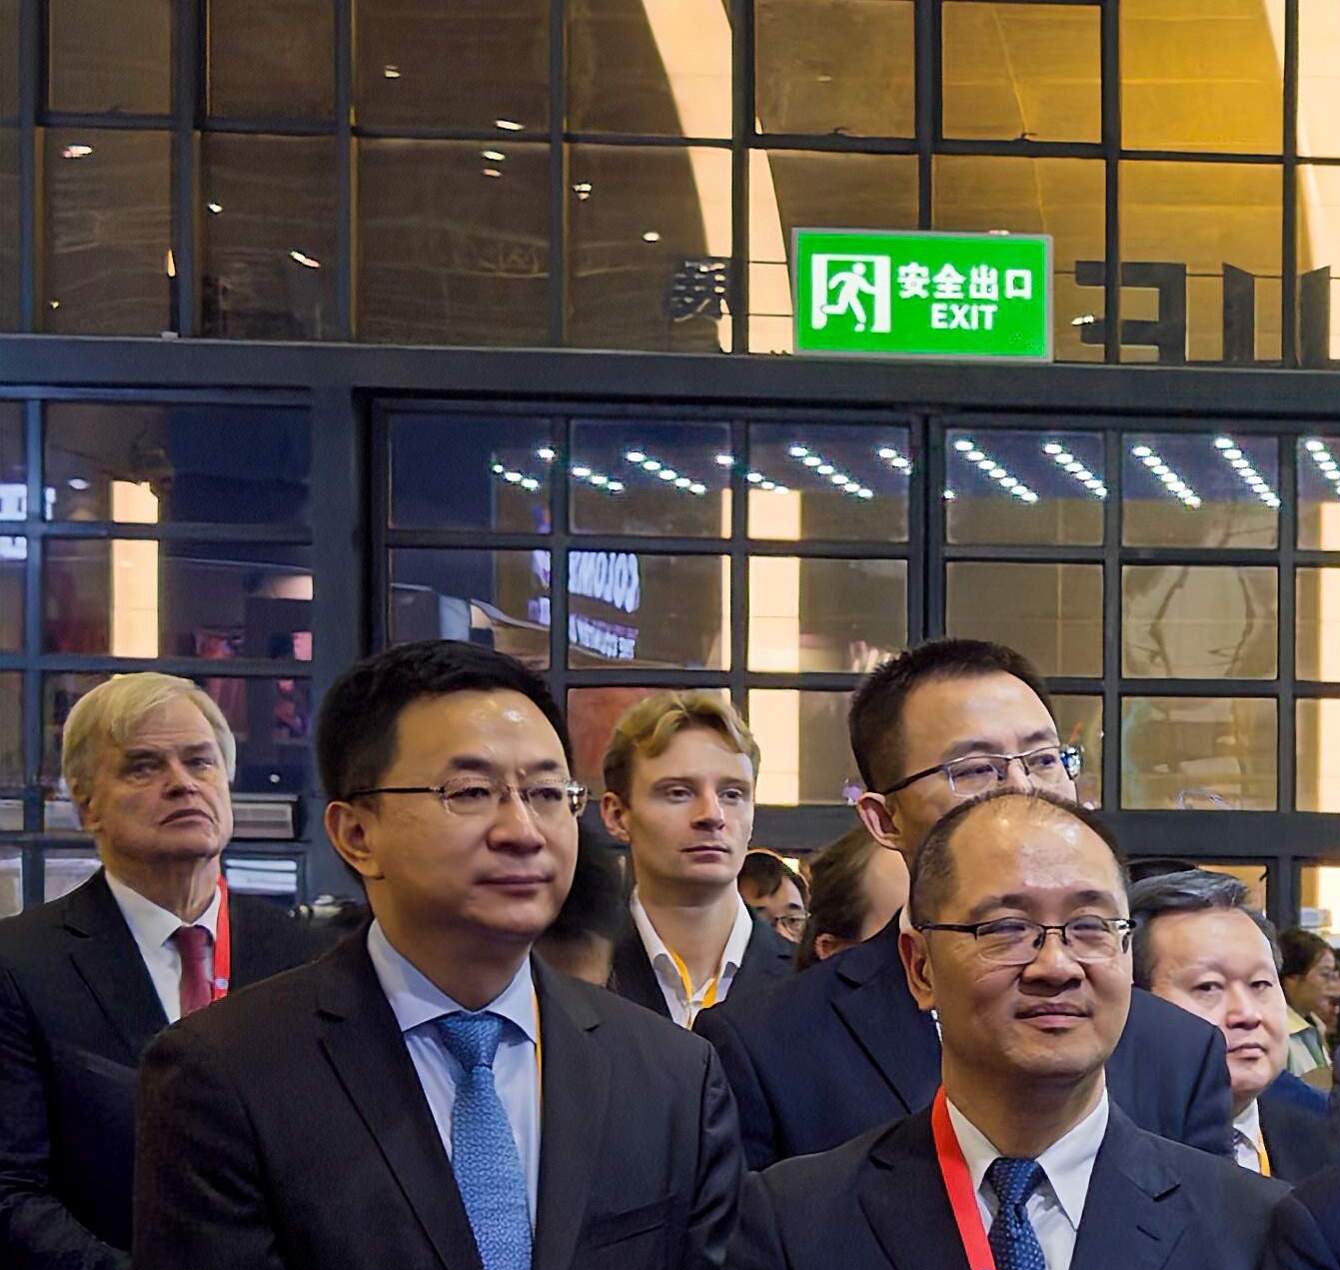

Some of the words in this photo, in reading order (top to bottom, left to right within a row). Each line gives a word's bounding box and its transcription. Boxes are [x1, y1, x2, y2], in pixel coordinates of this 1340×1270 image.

[898, 262, 1032, 301] 安全出口
[931, 303, 998, 330] EXIT
